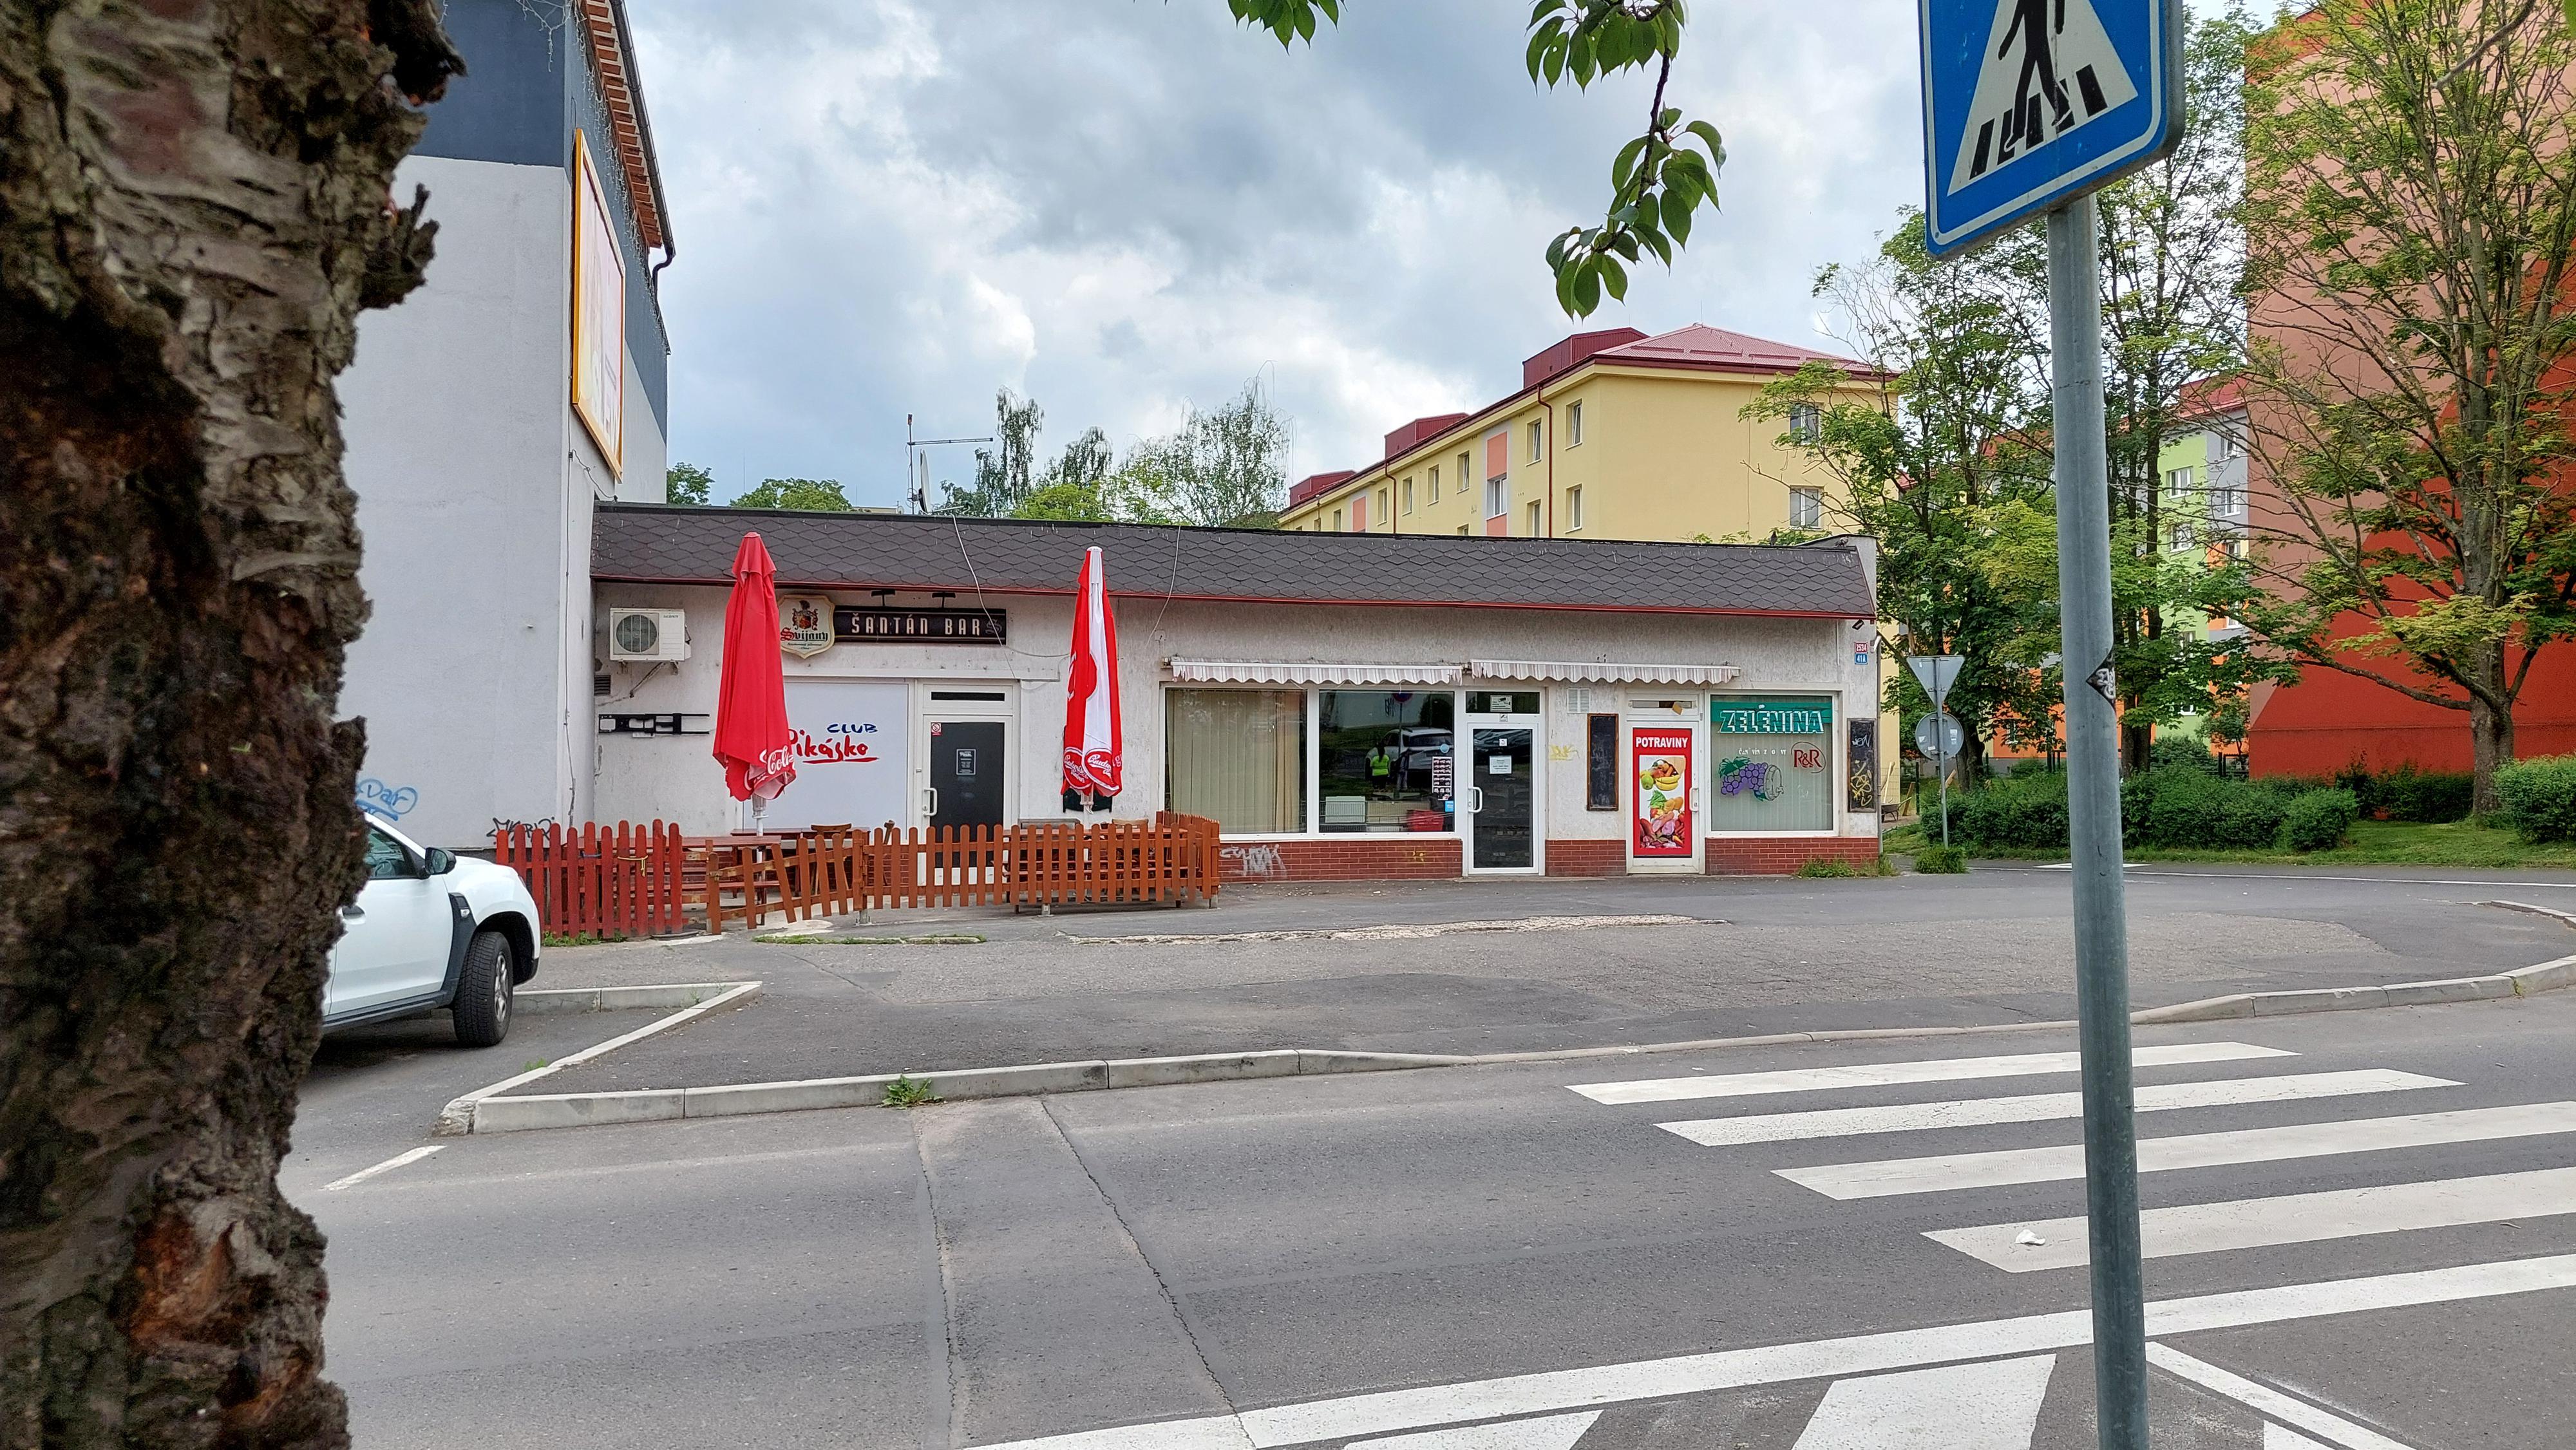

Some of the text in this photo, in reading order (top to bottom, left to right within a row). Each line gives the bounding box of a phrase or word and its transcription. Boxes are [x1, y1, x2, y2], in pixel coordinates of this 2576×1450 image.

[851, 612, 980, 636] ŠANTÁN BAR
[780, 626, 828, 641] Svijany
[1857, 654, 1866, 663] 41A
[827, 723, 878, 733] CLUB
[1636, 737, 1689, 748] POTRAVINY
[1794, 749, 1823, 768] R&R
